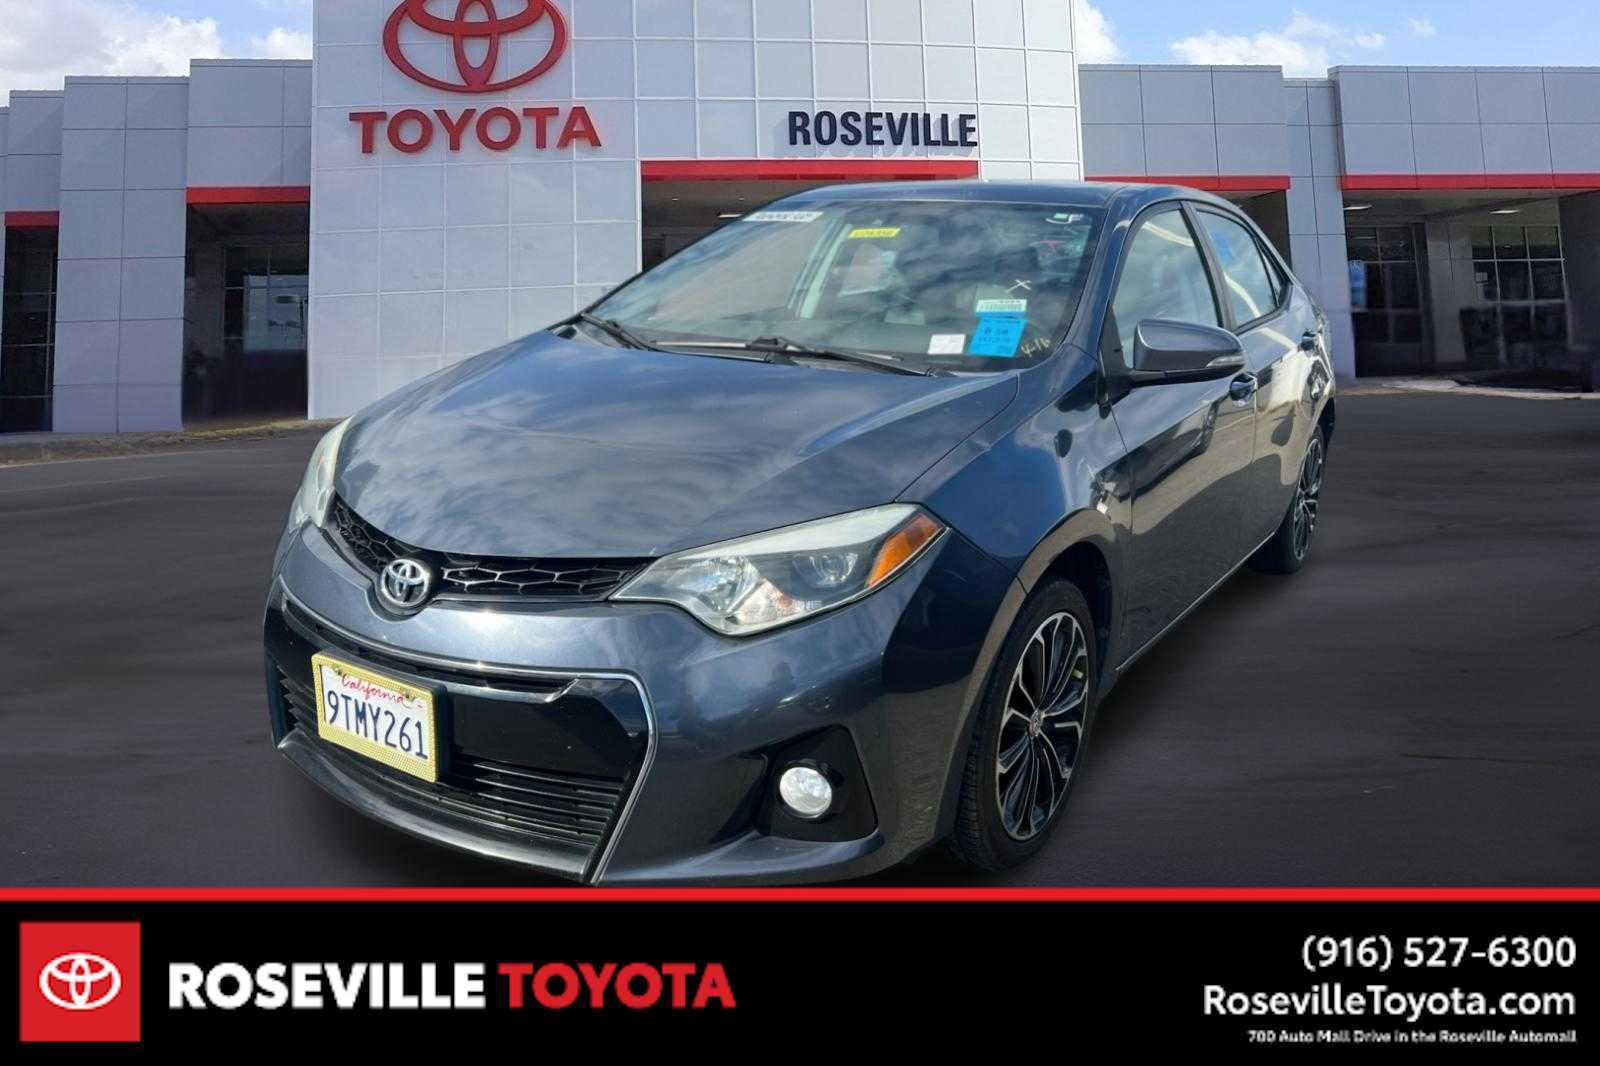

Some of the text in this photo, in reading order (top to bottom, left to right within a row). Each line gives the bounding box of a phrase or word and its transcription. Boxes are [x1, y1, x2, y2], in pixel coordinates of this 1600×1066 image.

[349, 106, 602, 153] TOYOTA
[788, 110, 978, 147] ROSEVILLE
[340, 674, 408, 708] California
[326, 690, 428, 760] 9TMY261
